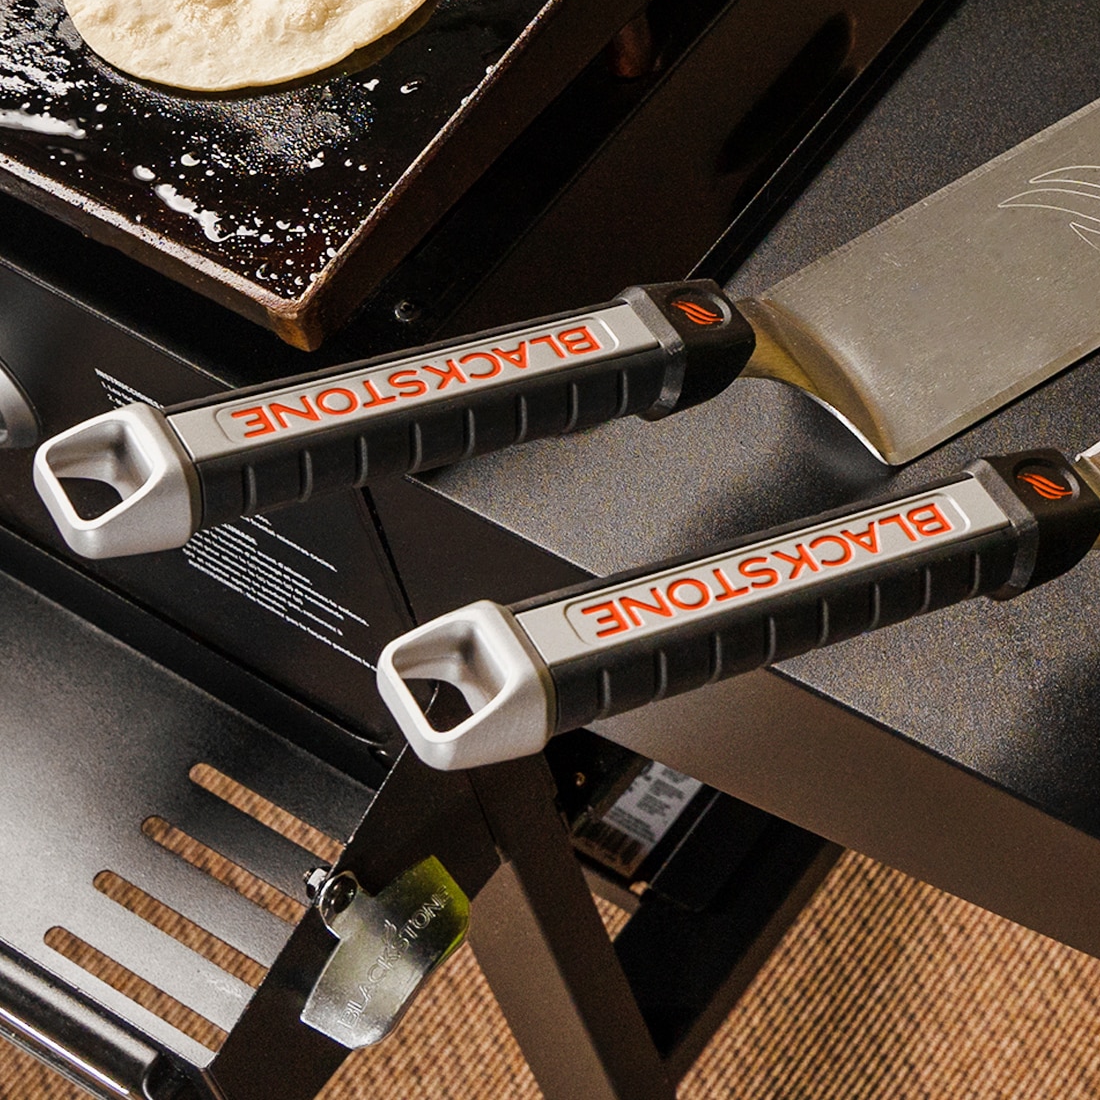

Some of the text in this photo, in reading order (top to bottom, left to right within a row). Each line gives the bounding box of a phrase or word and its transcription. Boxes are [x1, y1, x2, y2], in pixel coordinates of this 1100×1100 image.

[230, 325, 601, 438] BLACKSTONE
[581, 502, 953, 638] BLACKSTONE
[337, 885, 452, 1029] BLACKSTONE
